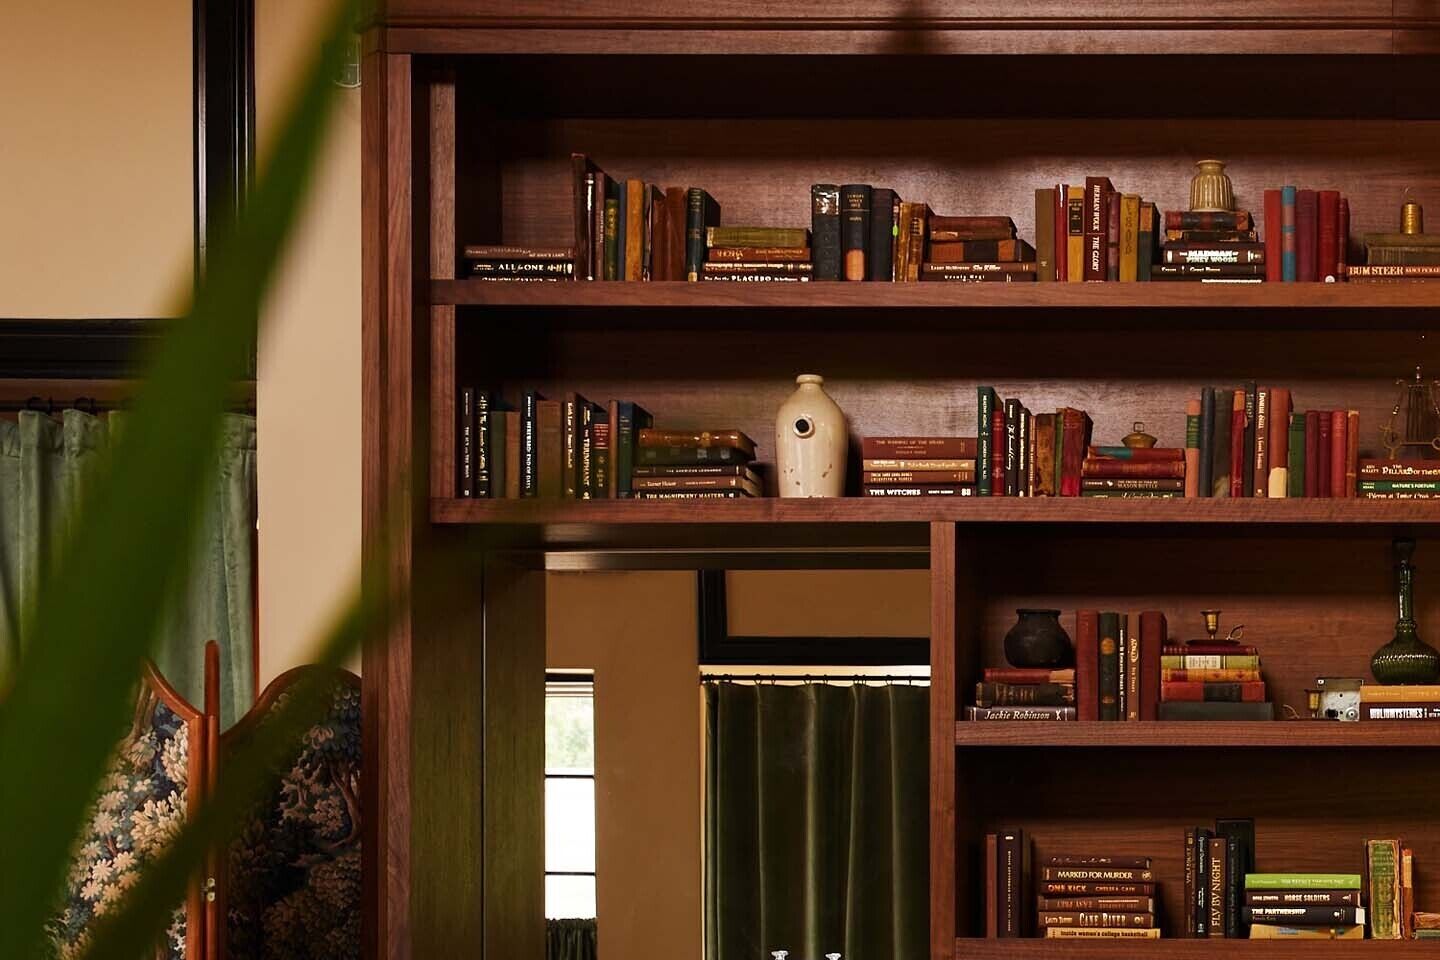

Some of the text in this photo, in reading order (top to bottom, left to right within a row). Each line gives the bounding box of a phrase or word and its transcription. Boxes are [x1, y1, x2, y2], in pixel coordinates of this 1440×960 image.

[1092, 185, 1101, 231] HERMAN WOUK
[1091, 236, 1100, 272] THE GLORY
[1349, 266, 1404, 275] BUM STEER
[583, 438, 591, 487] TRIUMPHANT
[984, 710, 1050, 720] Jackie Robinson
[1057, 871, 1133, 879] MARKED FOR MURDER
[1210, 857, 1222, 926] FLY BY NIGHT
[1079, 913, 1126, 927] CANE RIVER
